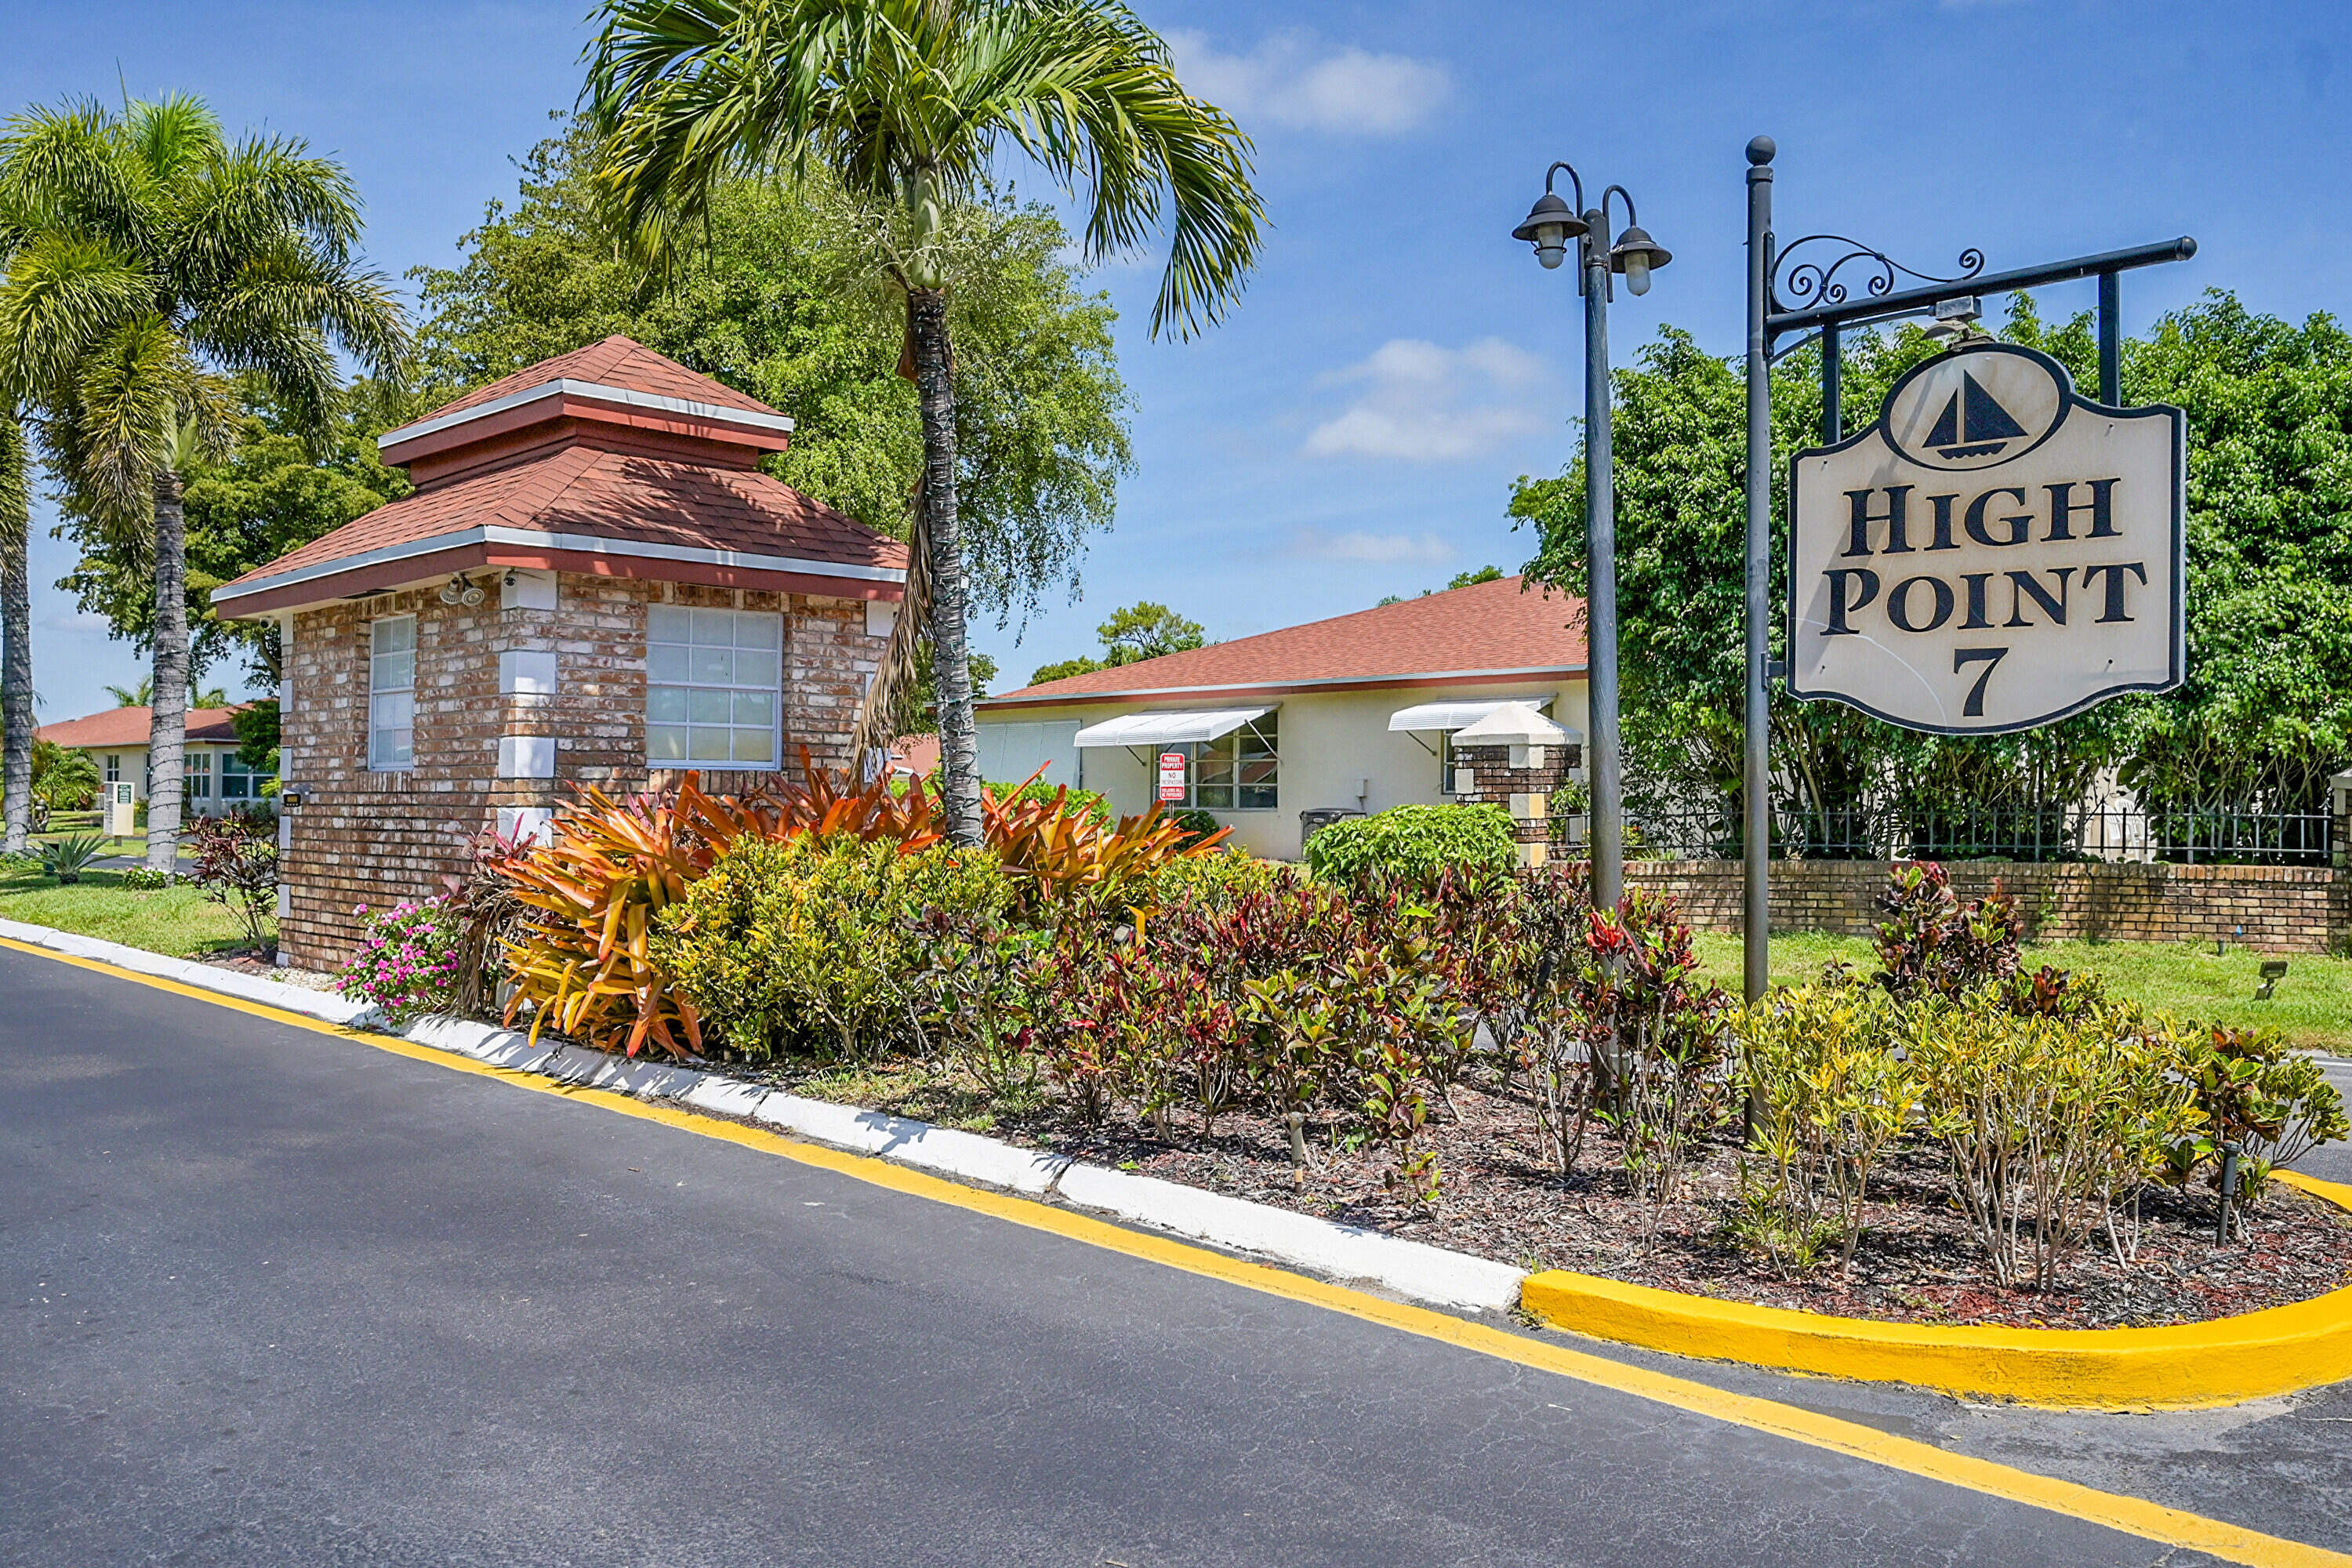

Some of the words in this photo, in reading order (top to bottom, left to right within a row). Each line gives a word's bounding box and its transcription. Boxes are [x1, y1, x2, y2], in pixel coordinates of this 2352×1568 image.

[1840, 477, 2123, 558] HIGH
[1819, 561, 2149, 637] POINT
[1953, 647, 2009, 717] 7
